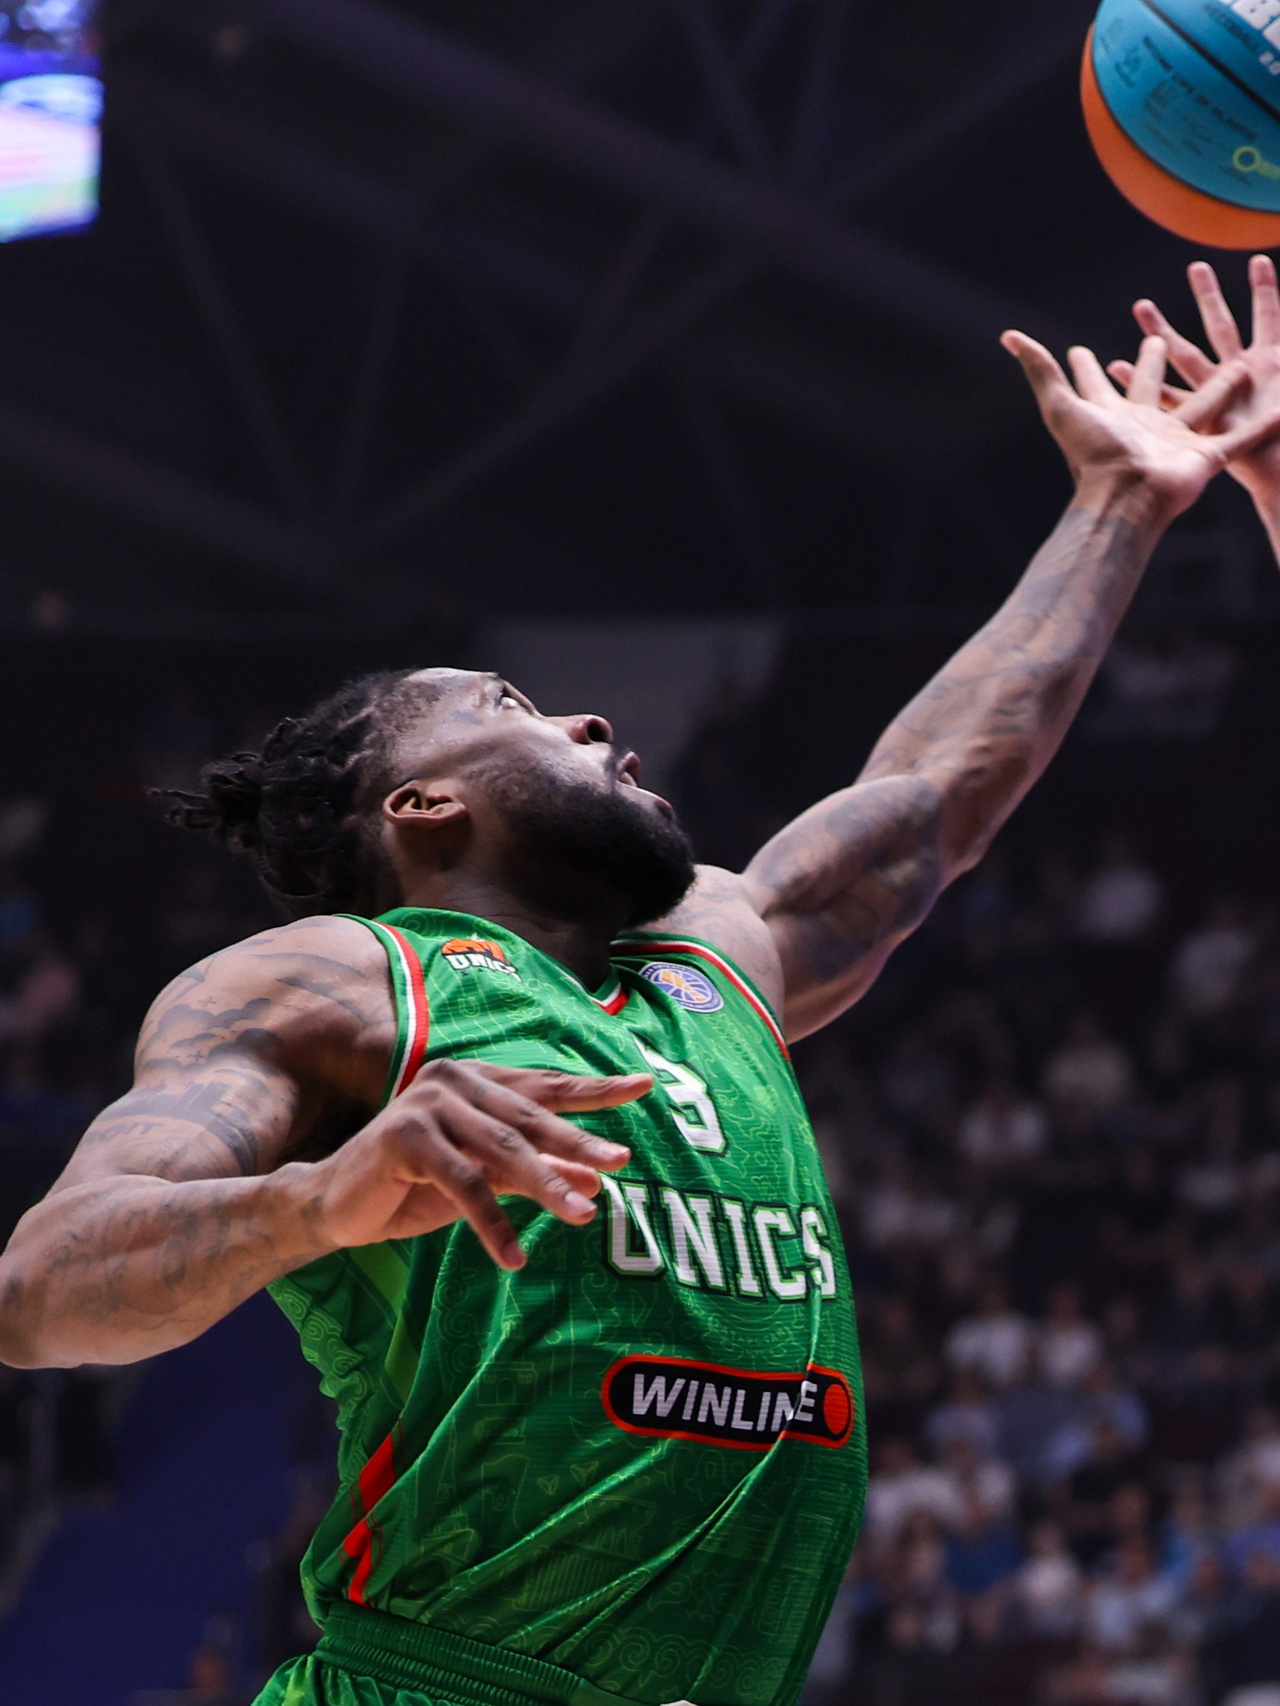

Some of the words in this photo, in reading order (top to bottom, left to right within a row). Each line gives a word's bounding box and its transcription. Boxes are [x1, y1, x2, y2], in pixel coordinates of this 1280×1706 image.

[631, 1032, 727, 1154] 3
[600, 1174, 837, 1300] UNICS
[632, 1373, 818, 1432] WINLINE
